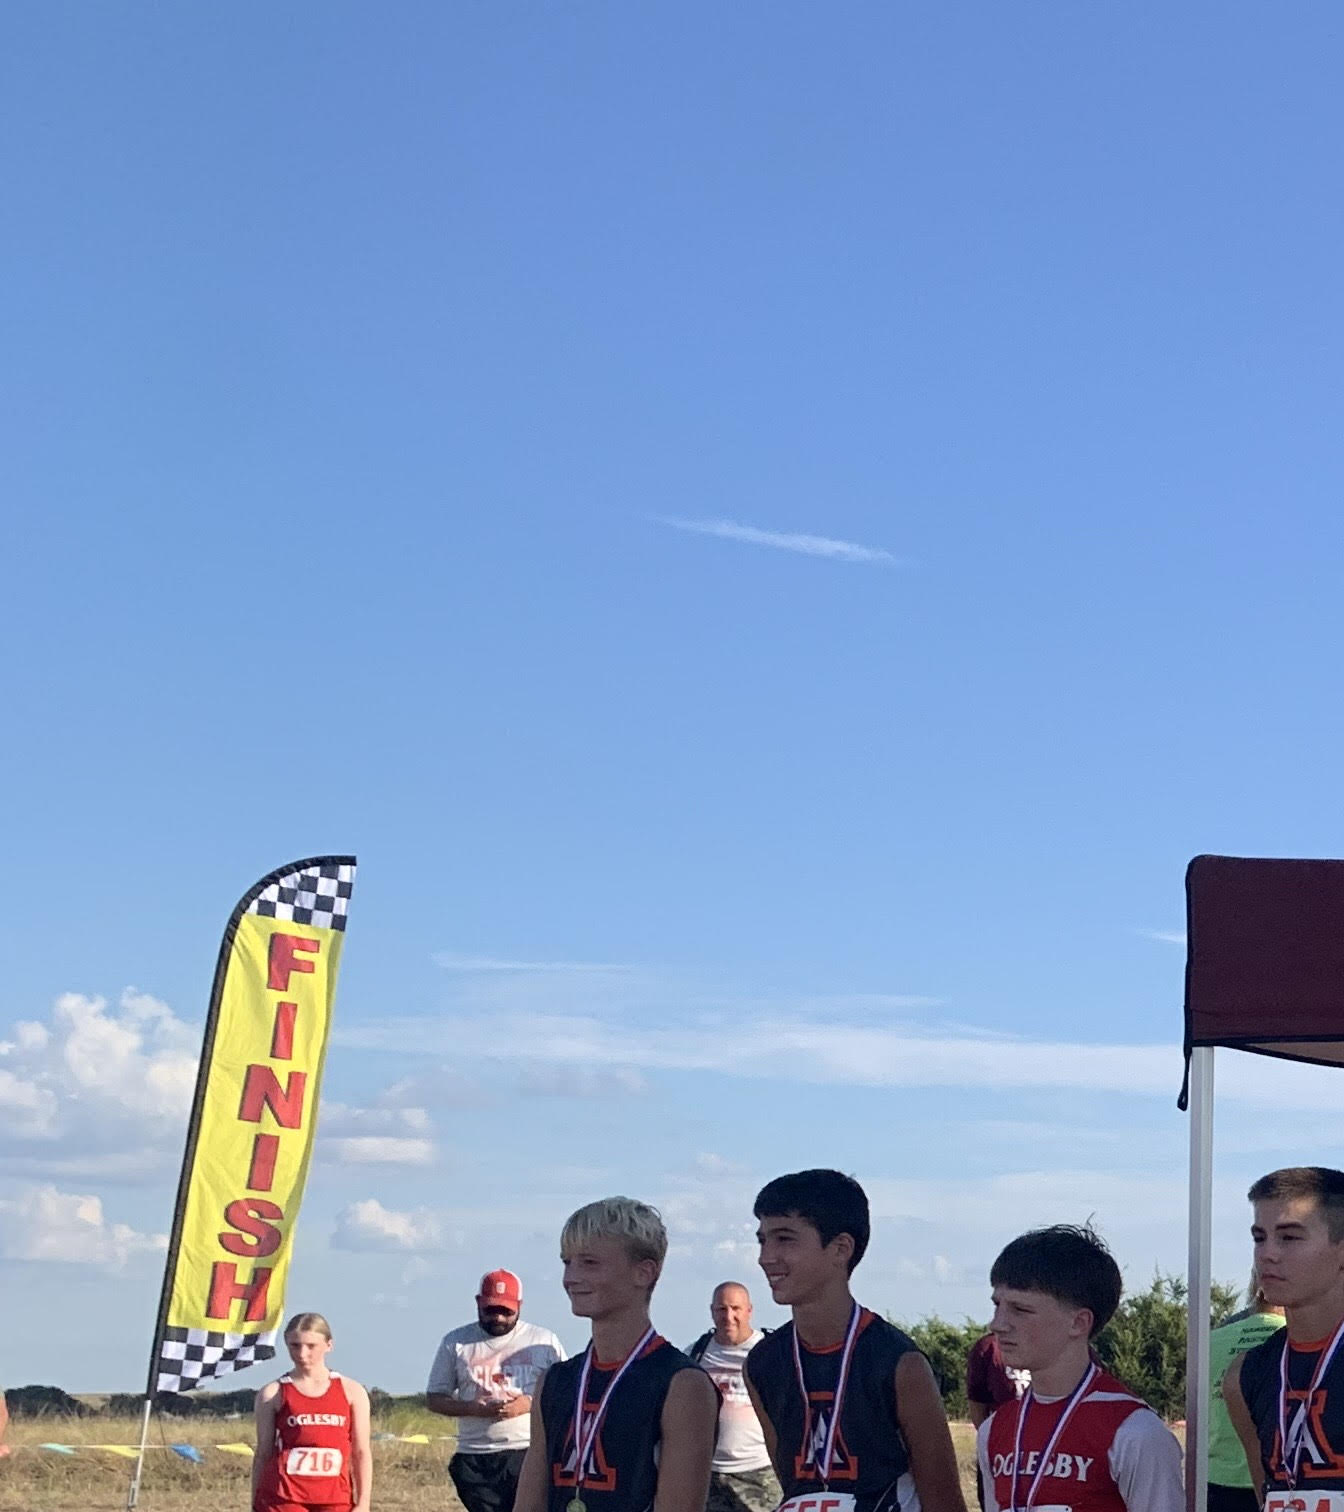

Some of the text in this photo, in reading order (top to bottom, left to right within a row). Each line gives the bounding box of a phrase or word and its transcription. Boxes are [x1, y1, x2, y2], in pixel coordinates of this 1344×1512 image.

[205, 931, 321, 1322] FINISH
[287, 1413, 347, 1428] OGLESBY
[295, 1450, 333, 1473] 716
